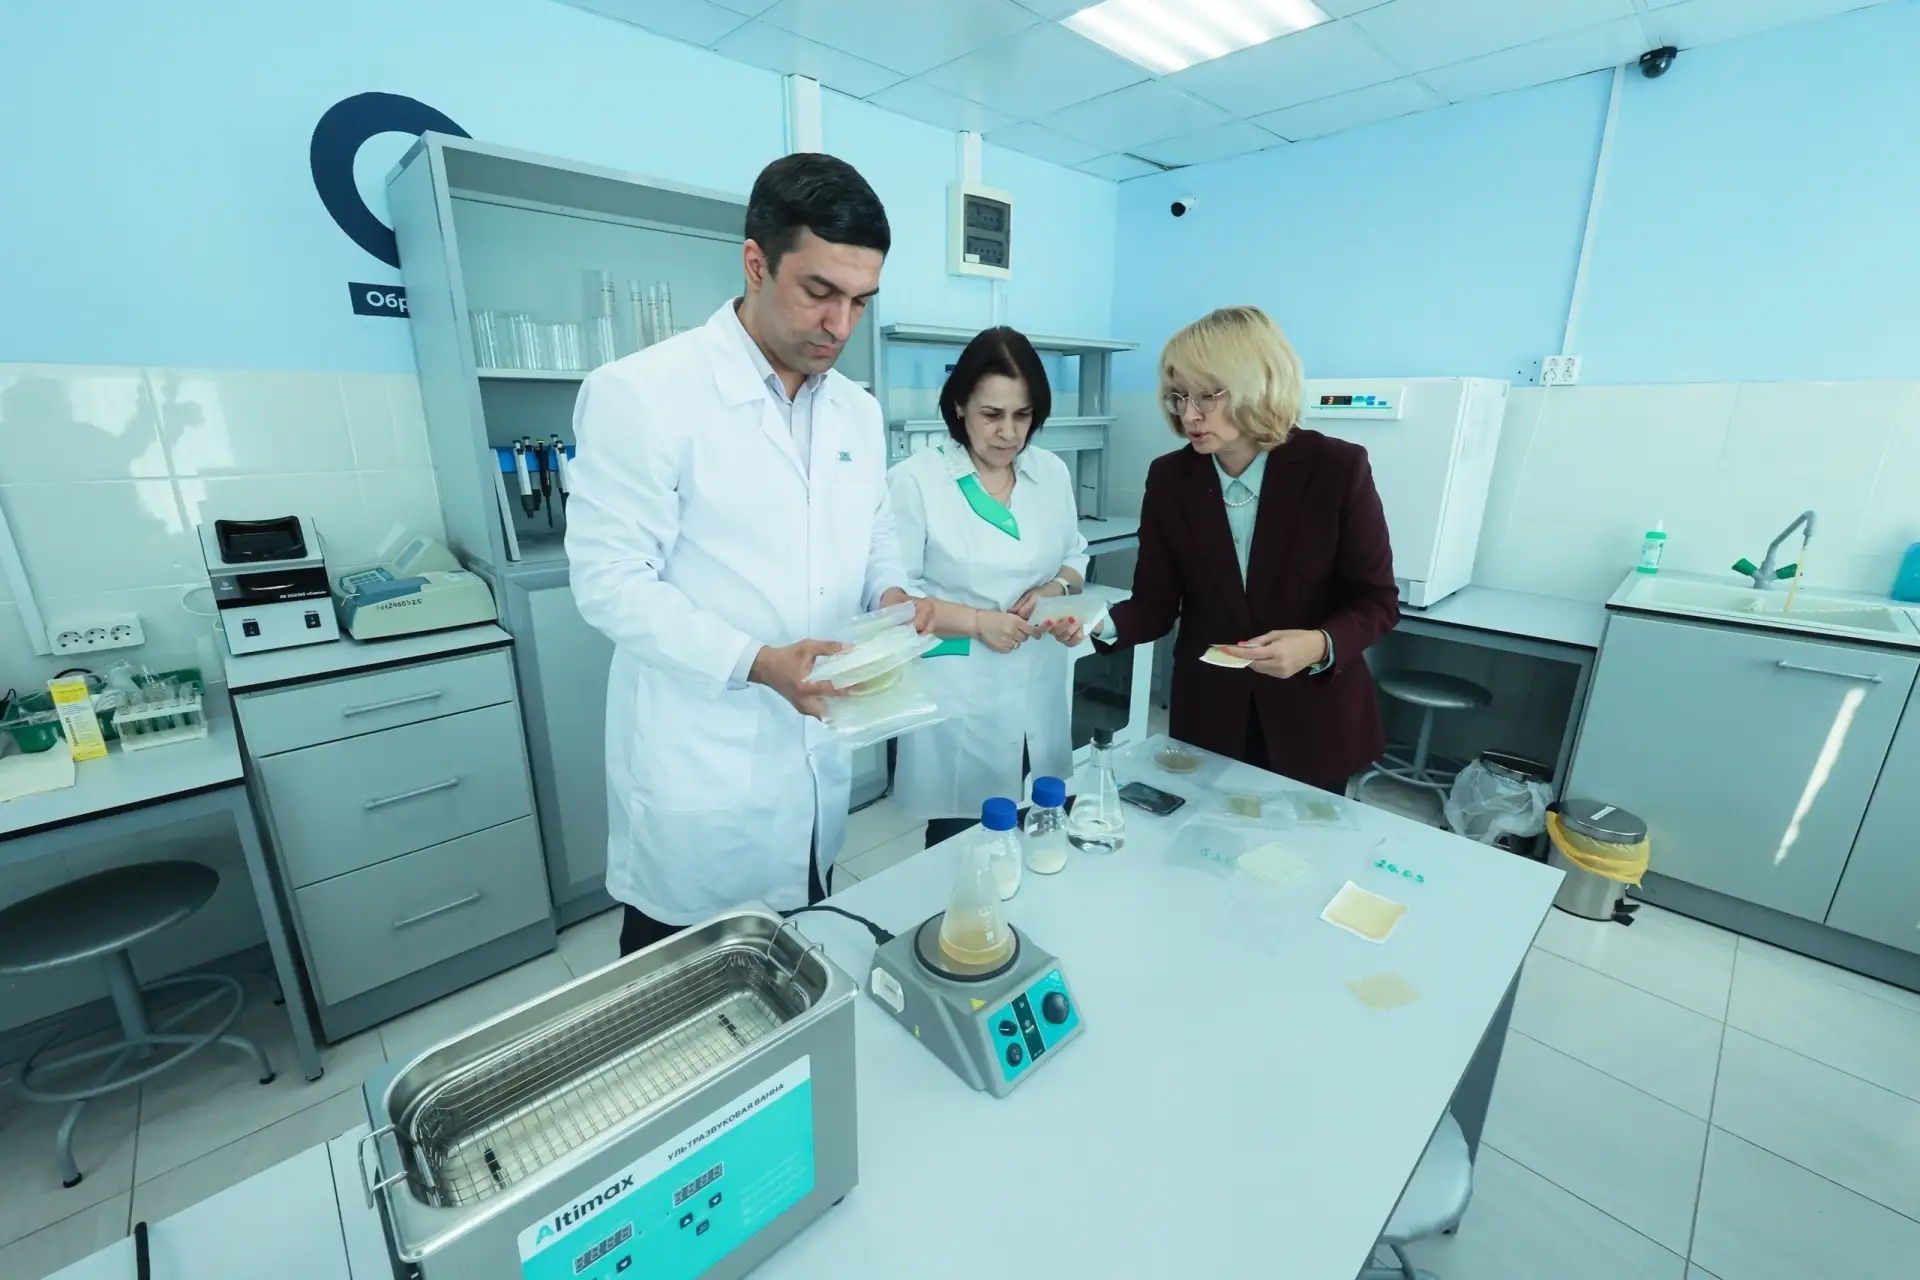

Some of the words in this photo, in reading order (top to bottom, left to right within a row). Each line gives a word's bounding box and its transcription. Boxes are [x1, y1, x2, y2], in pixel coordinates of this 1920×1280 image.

[366, 290, 408, 313] Обр
[667, 1102, 754, 1162] УЛЬТРАЗВУКОВАЯ
[754, 1083, 785, 1106] ВАННА
[535, 1174, 635, 1247] Altimax
